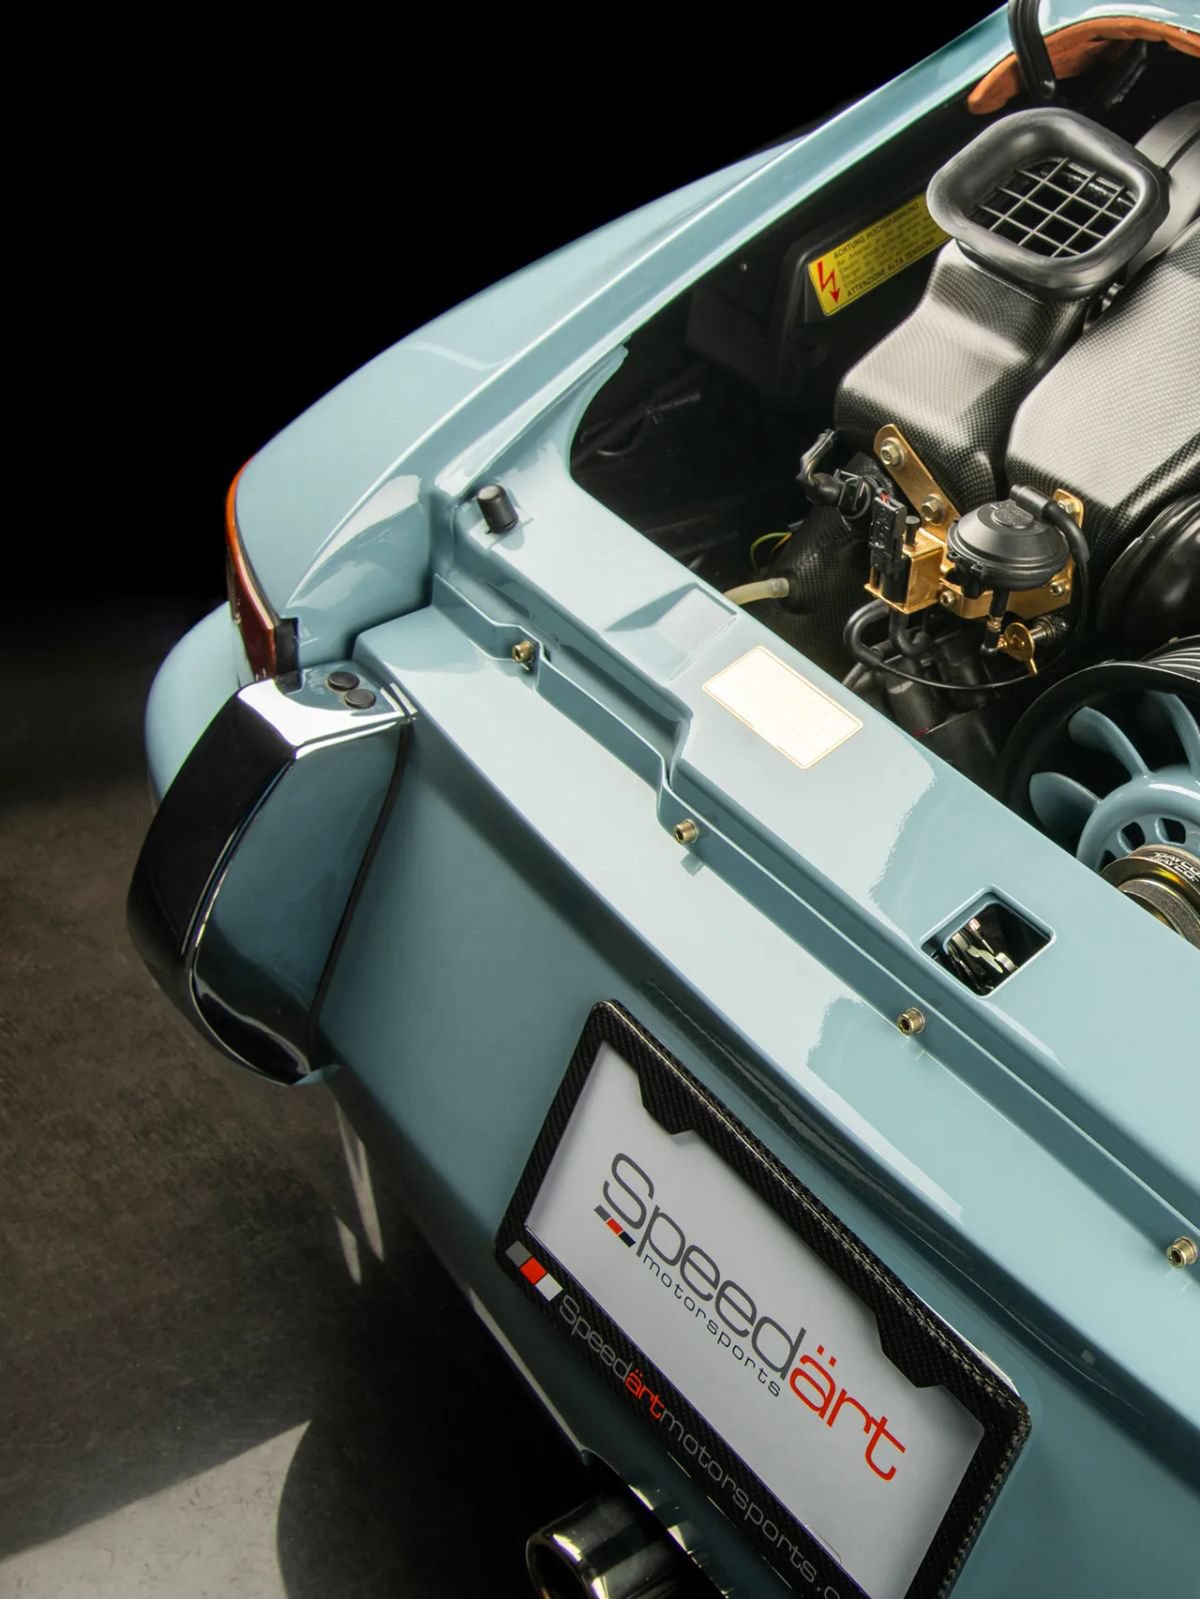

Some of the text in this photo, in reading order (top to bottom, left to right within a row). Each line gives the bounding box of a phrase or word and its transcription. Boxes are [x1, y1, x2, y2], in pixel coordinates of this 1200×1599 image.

[833, 235, 866, 258] ACHTUNG
[602, 1152, 906, 1481] Speedärt
[641, 1252, 781, 1397] motorsports
